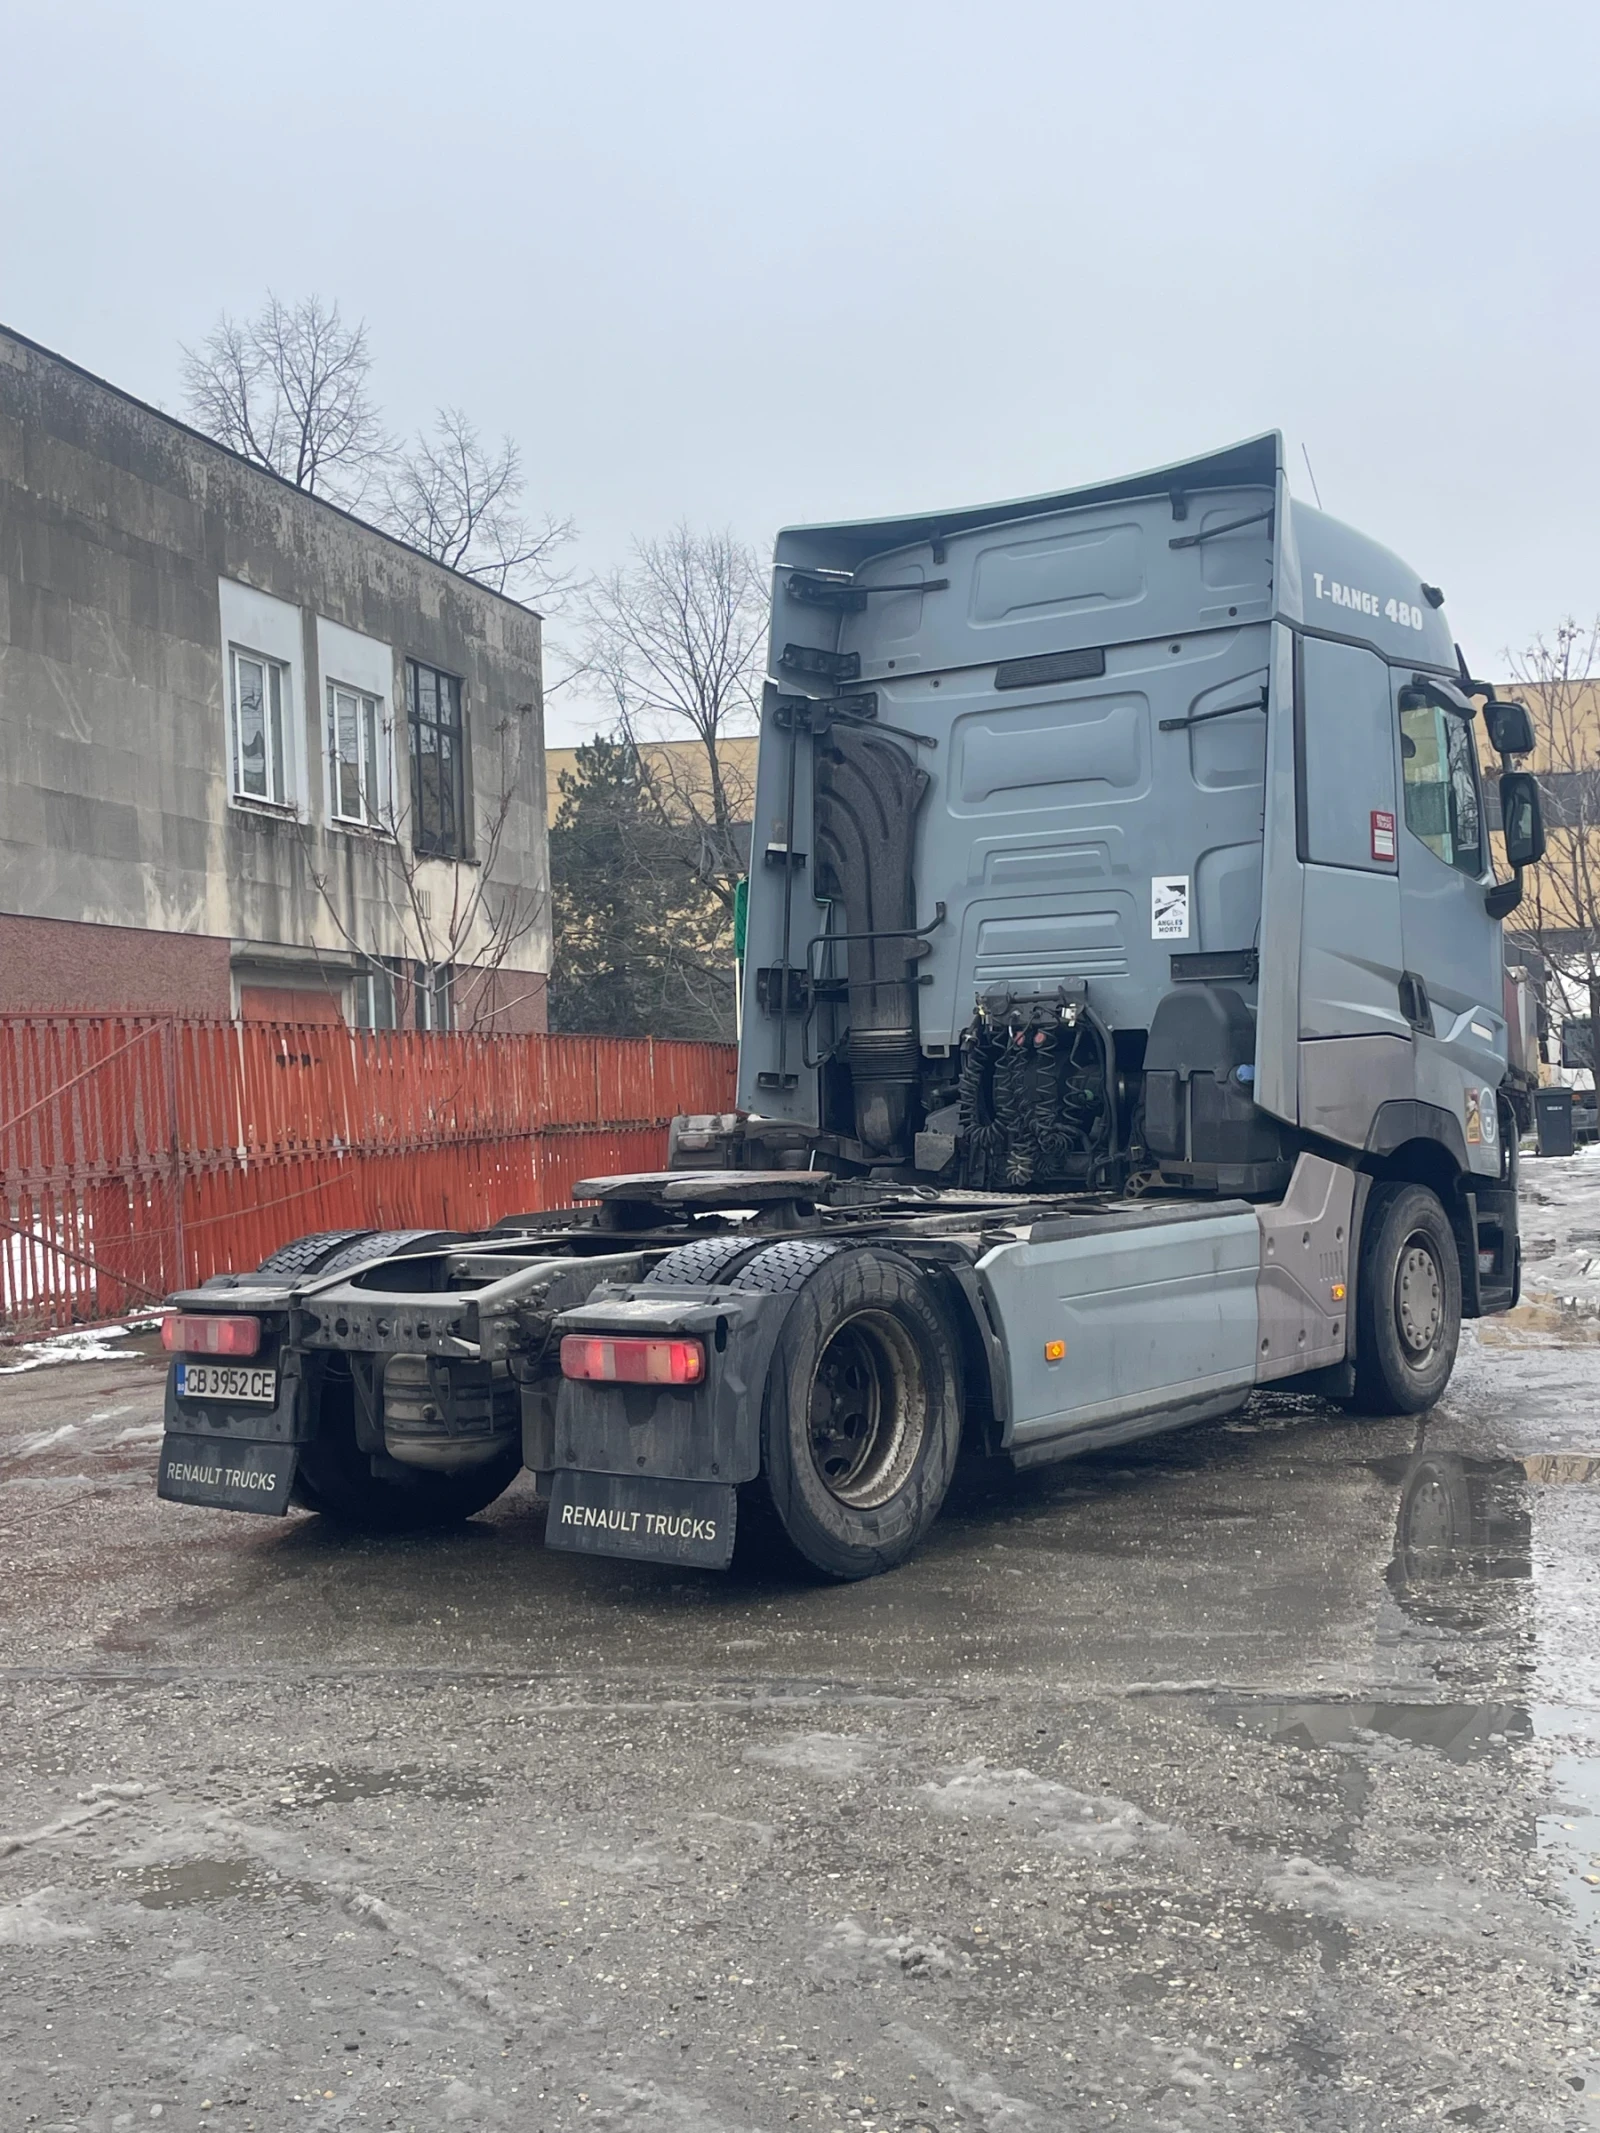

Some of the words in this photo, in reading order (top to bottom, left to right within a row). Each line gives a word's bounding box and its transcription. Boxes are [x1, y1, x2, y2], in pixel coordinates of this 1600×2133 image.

[1313, 572, 1380, 617] T-RANGE
[1384, 598, 1423, 631] 480
[187, 1369, 207, 1393] CB
[209, 1369, 248, 1396] 3952
[251, 1372, 272, 1397] CE
[166, 1462, 222, 1484] RENAULT
[224, 1468, 276, 1491] TRUCKS
[561, 1504, 640, 1532] RENAULT
[645, 1513, 716, 1540] TRUCKS
